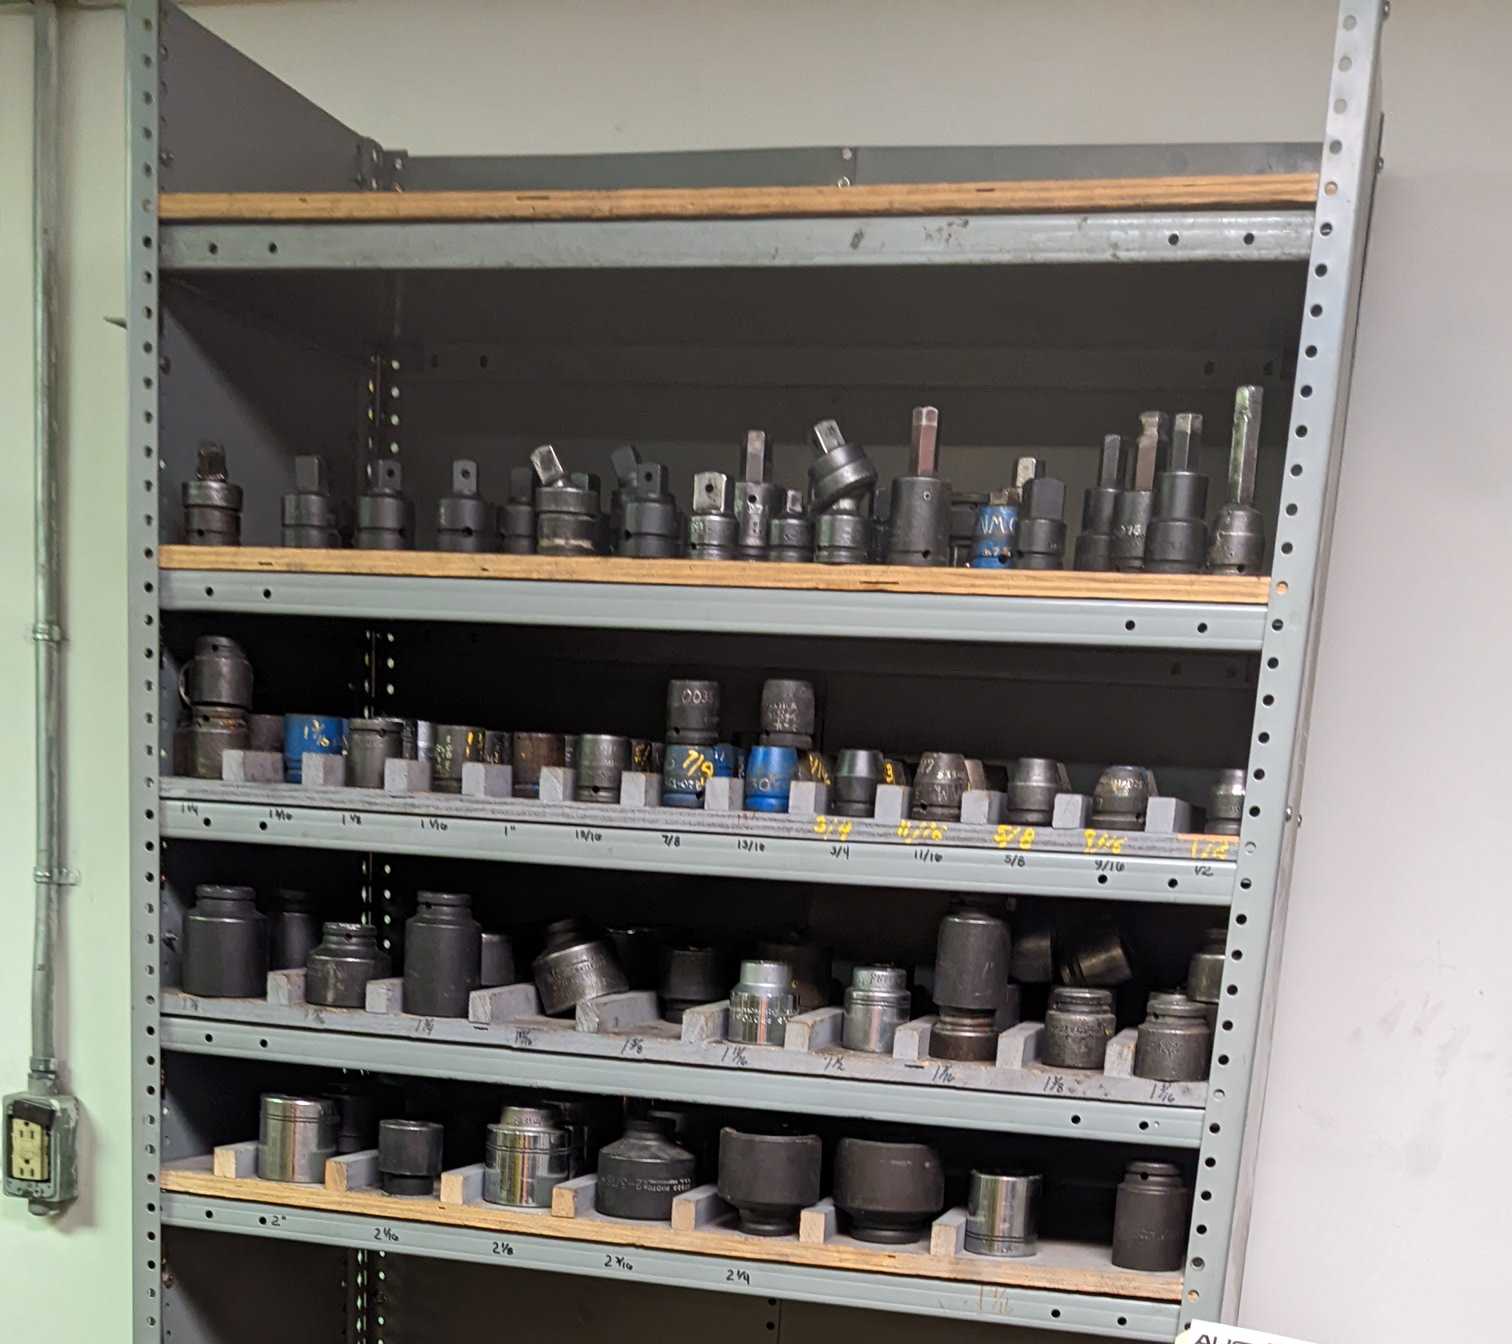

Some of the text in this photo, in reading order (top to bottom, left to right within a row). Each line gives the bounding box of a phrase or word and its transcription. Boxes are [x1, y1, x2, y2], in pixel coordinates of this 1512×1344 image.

[662, 834, 681, 848] 7/8
[829, 845, 850, 860] 3/4
[913, 850, 943, 863] 11/16
[1004, 854, 1026, 867] 5/8
